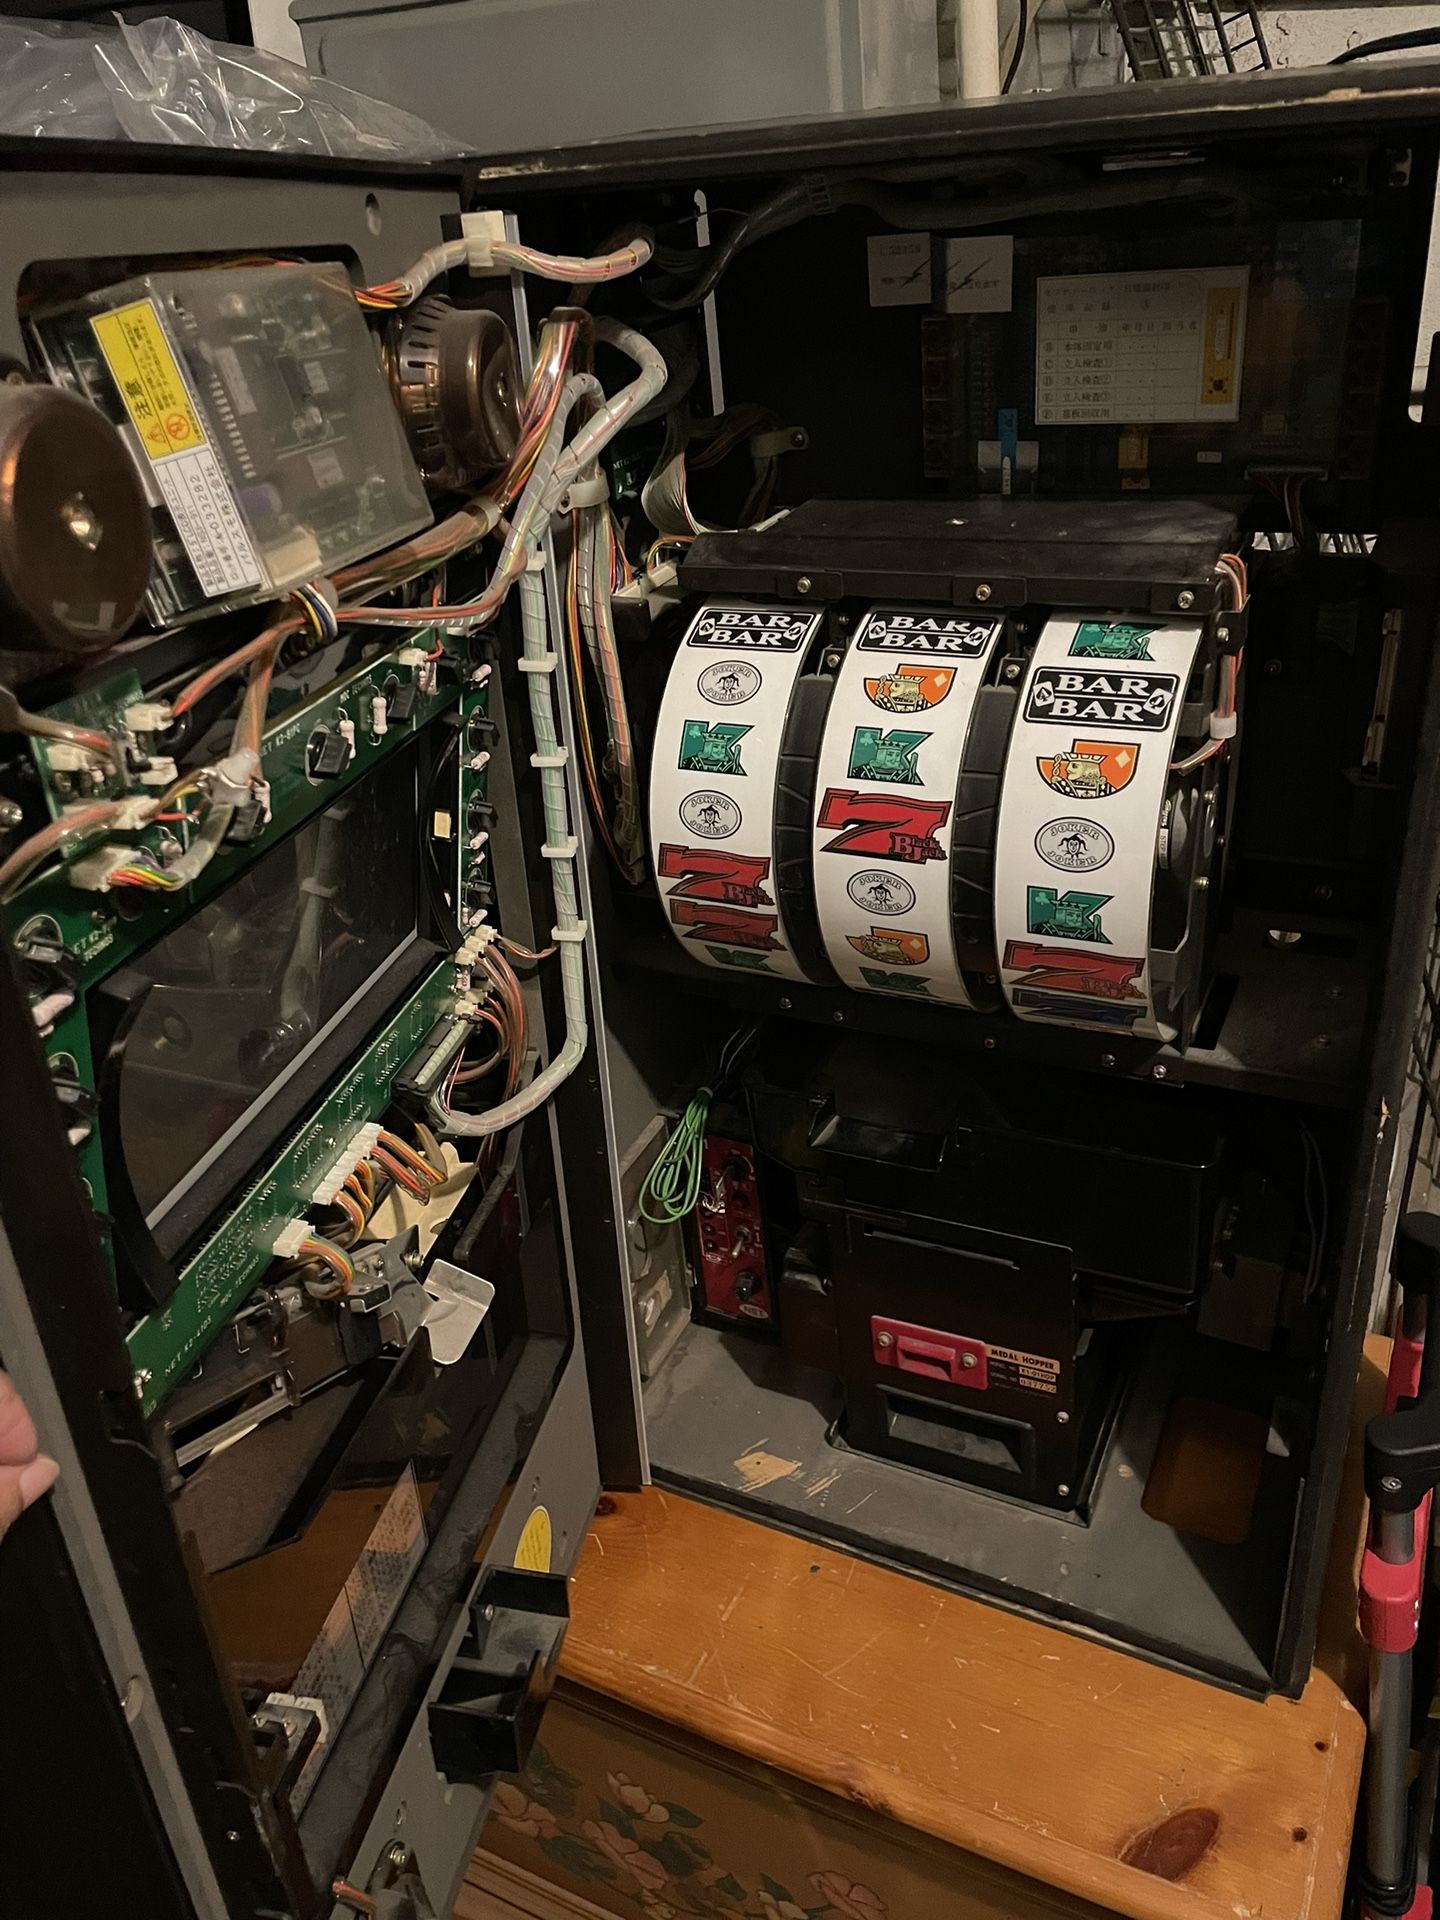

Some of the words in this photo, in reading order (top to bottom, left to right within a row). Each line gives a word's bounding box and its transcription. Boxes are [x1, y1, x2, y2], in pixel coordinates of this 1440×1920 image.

[125, 380, 153, 420] 注意
[717, 613, 792, 628] BAR
[888, 616, 971, 632] BAR
[707, 630, 782, 646] BAR
[880, 633, 963, 651] BAR
[712, 664, 751, 679] JOKER
[1055, 674, 1150, 697] BAR
[1048, 699, 1145, 722] BAR
[690, 795, 730, 811] JOKER
[816, 787, 953, 865] 7
[1050, 823, 1100, 841] JOKER
[1047, 850, 1097, 866] JOKER
[658, 843, 772, 909] 7
[859, 874, 901, 890] JOKER
[1002, 939, 1148, 1000] 7
[991, 1349, 1018, 1361] MEDAL
[1022, 1356, 1054, 1370] HOPPER
